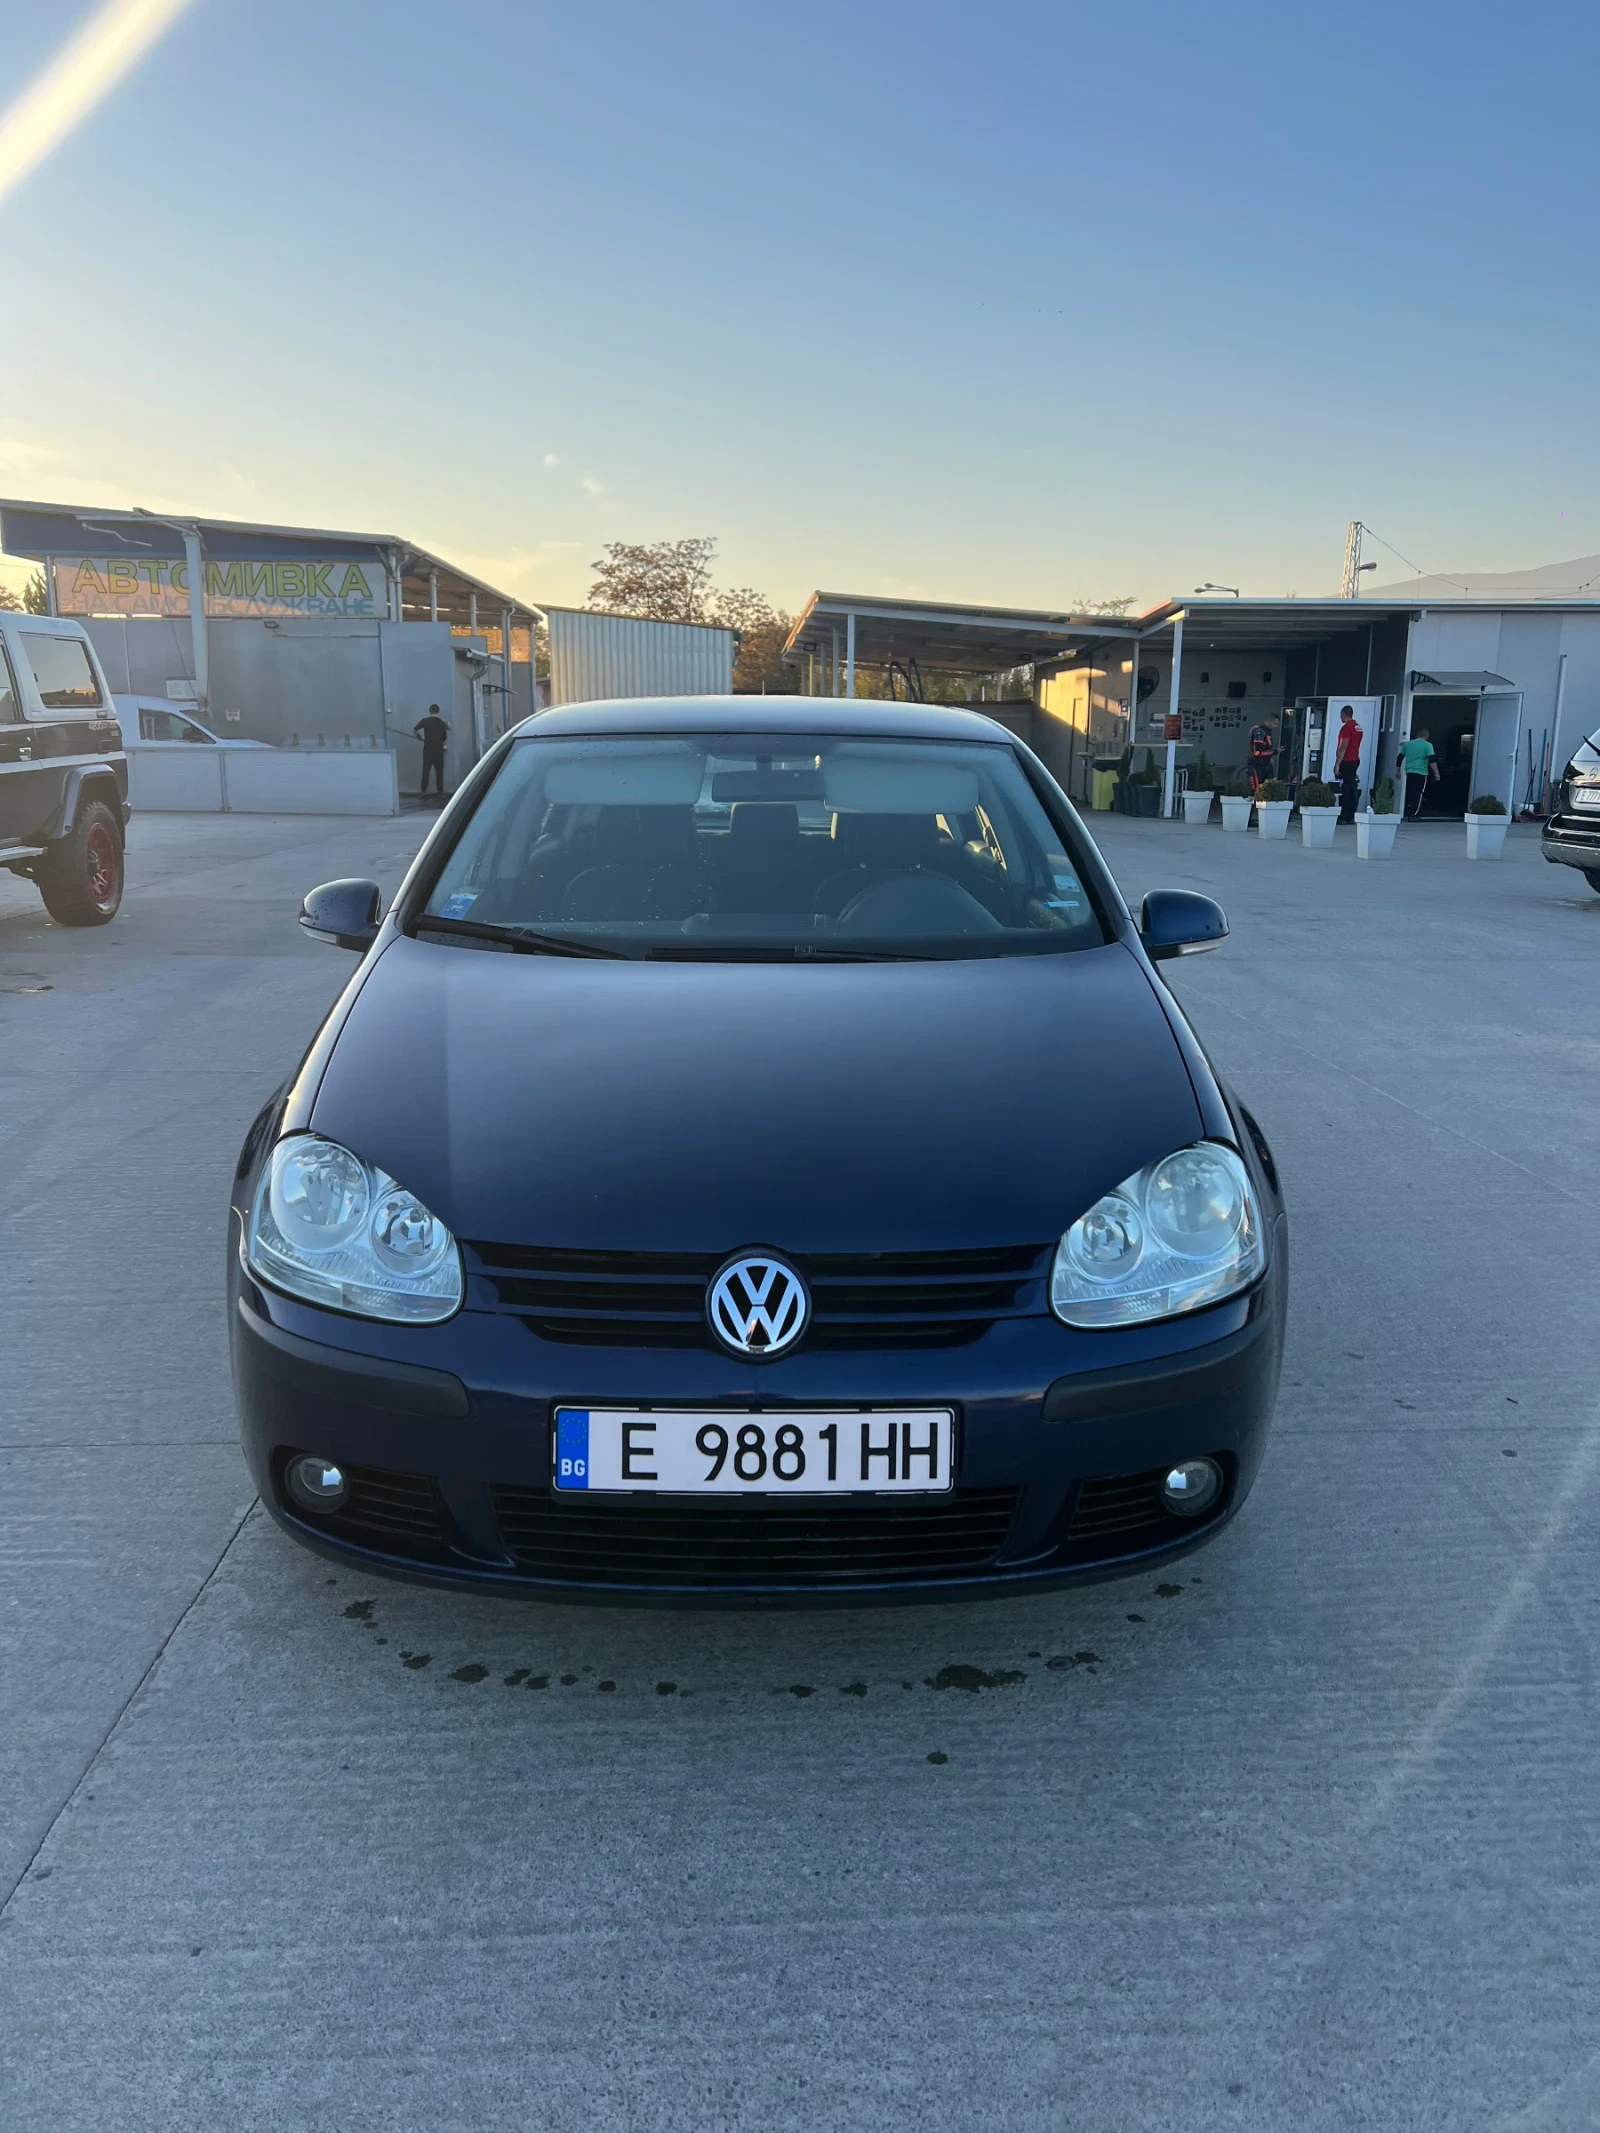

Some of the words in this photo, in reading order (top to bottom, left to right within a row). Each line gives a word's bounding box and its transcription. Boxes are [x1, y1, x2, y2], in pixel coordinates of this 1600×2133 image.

[71, 559, 373, 598] АВТОМИВКА
[114, 595, 374, 616] САМОБСЛУЖВАНЕ
[711, 1258, 806, 1352] VW
[561, 1458, 586, 1477] BG
[621, 1422, 658, 1480] E
